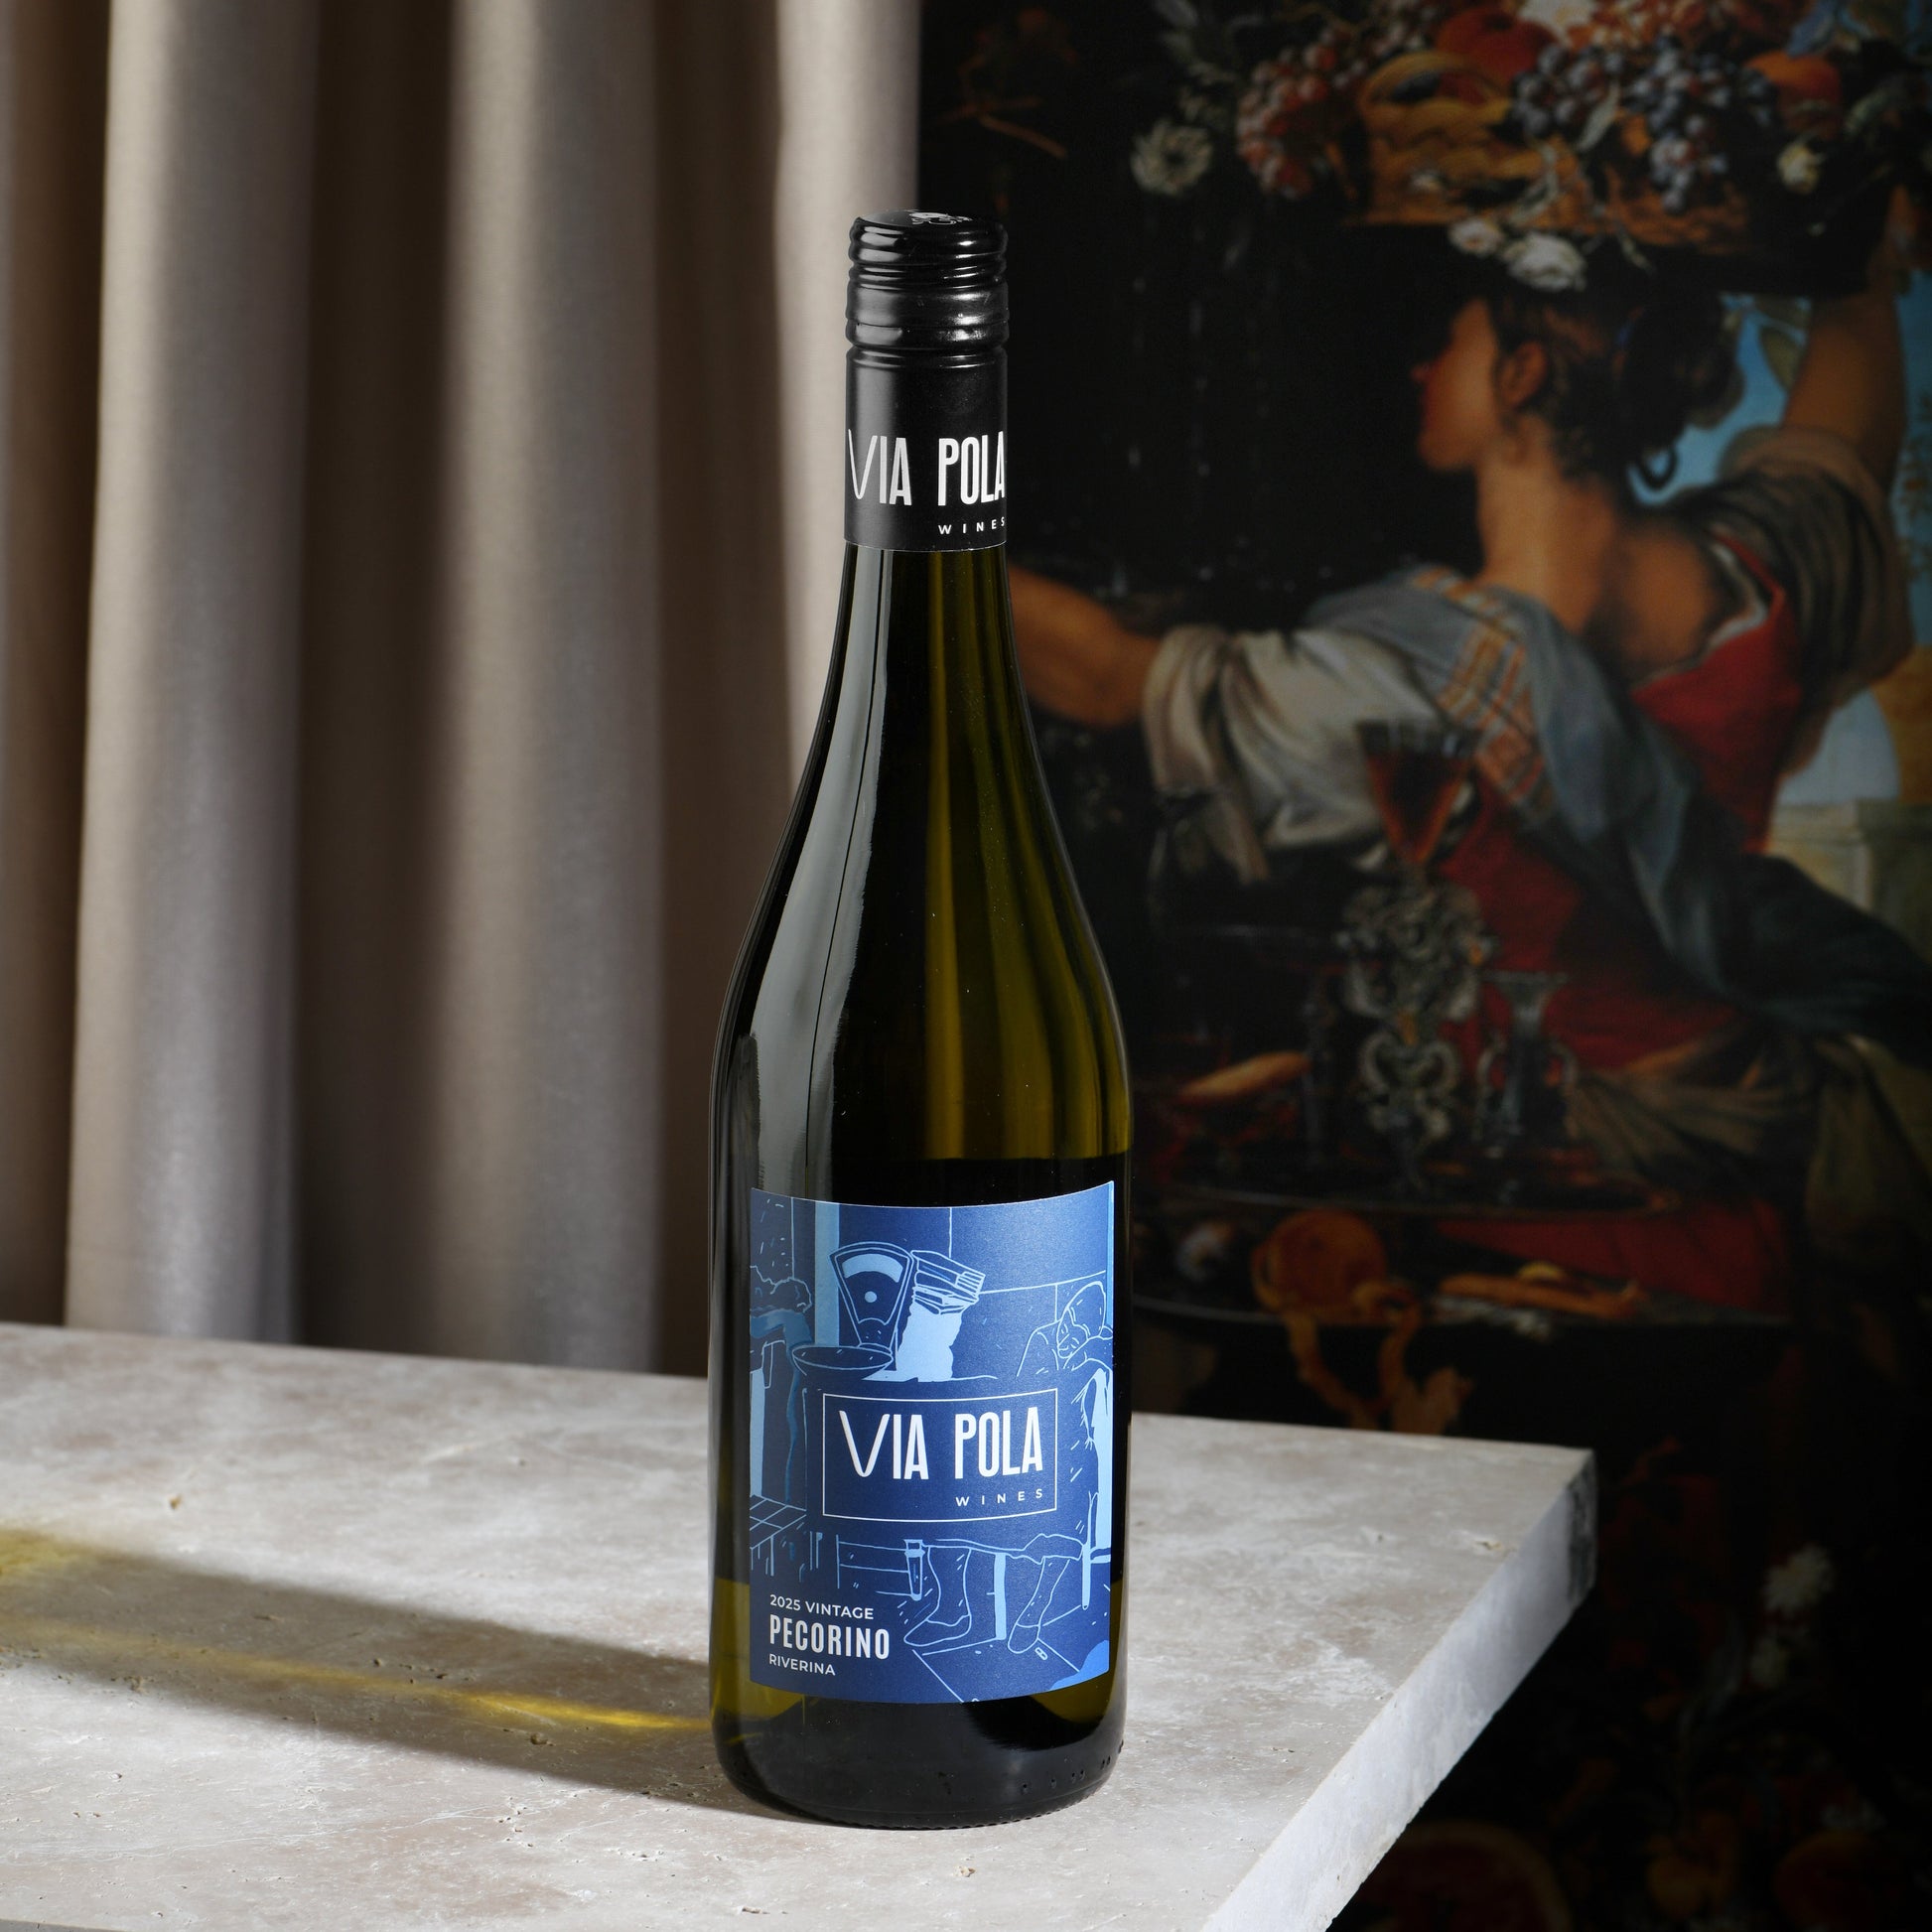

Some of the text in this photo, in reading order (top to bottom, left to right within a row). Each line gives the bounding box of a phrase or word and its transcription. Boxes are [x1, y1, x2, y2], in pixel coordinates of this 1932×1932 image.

[848, 428, 1006, 506] VIA POLA
[937, 516, 1006, 535] WINES
[838, 1406, 1043, 1480] VIA POLA
[955, 1488, 1043, 1507] WINES
[769, 1593, 875, 1620] 2025 VINTAGE
[769, 1613, 890, 1660] PECORINO
[768, 1653, 836, 1676] RIVERINA
